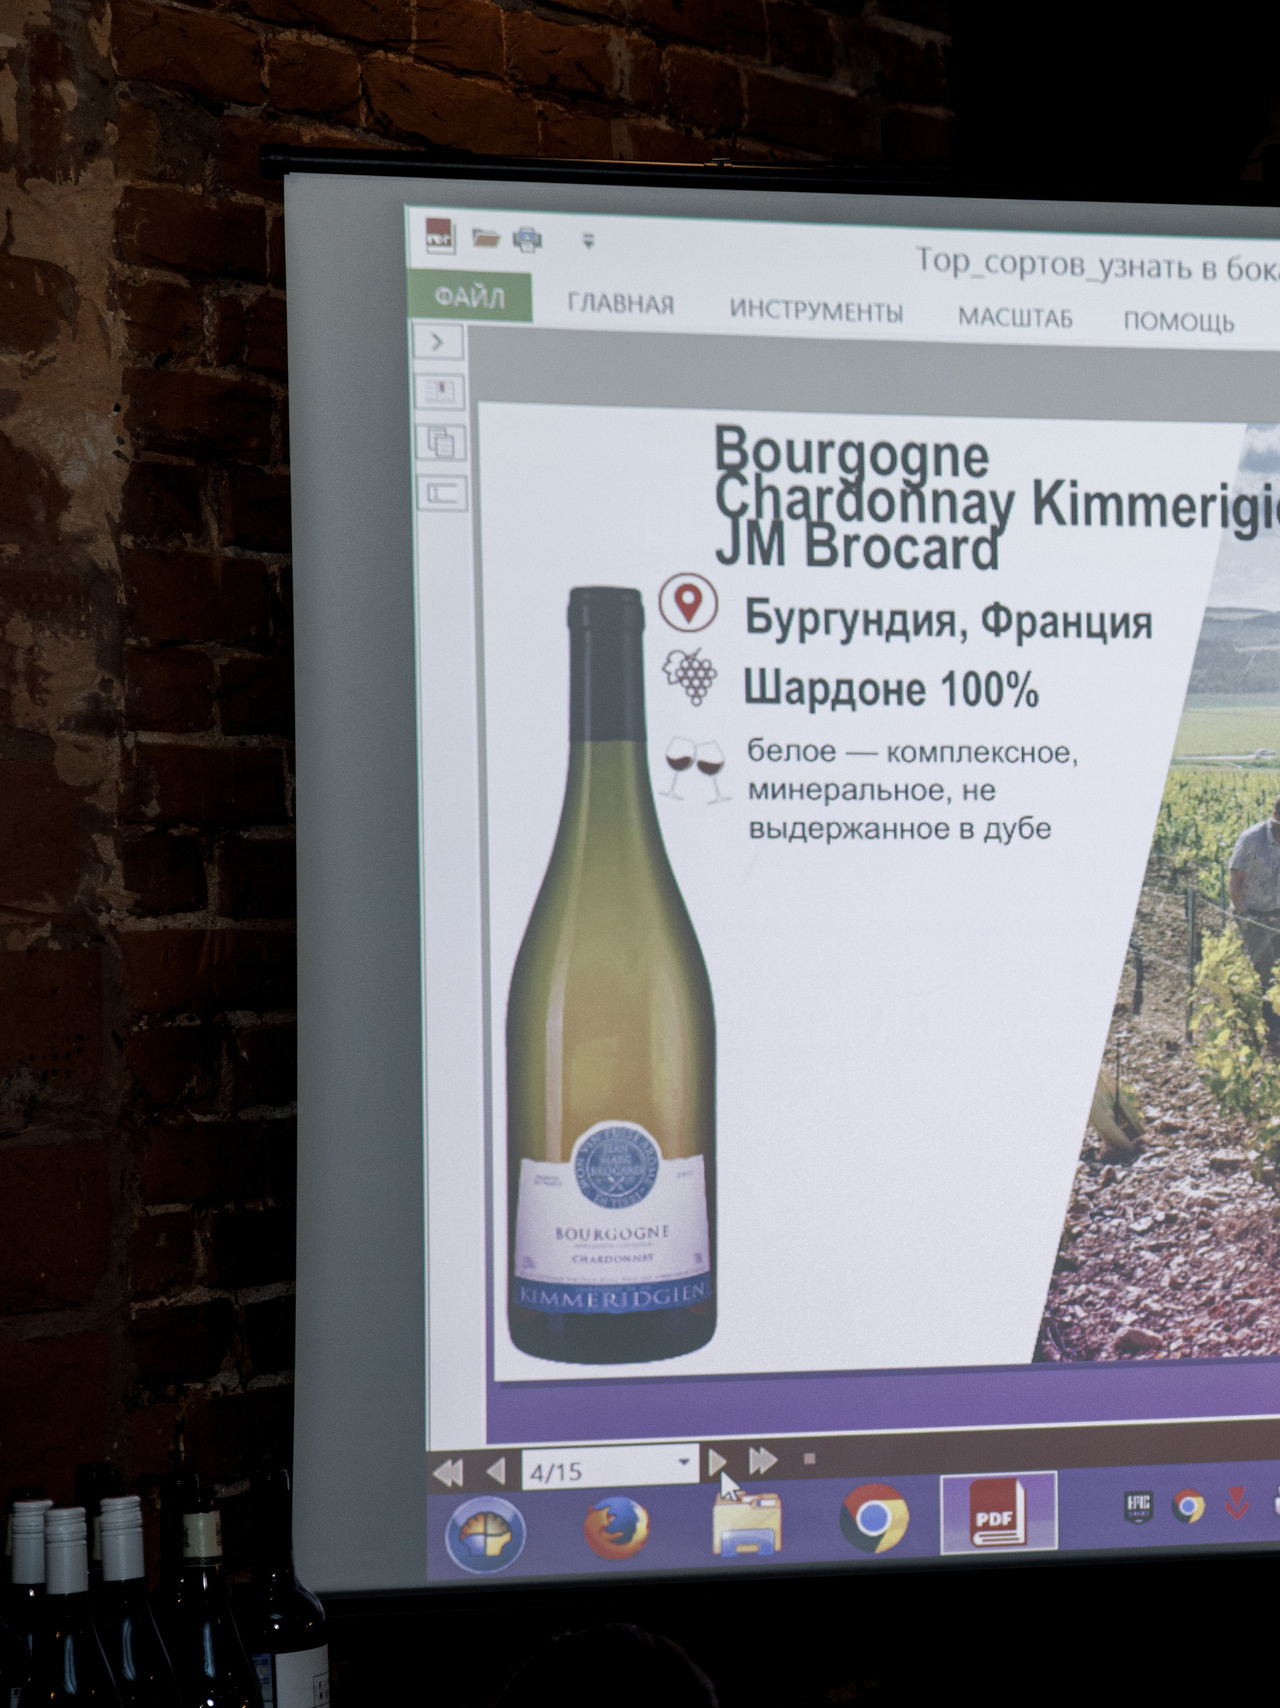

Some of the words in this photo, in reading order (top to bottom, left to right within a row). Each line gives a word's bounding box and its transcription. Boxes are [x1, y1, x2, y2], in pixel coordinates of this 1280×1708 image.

[1203, 260, 1217, 281] в
[435, 282, 506, 309] ФАЙЛ
[568, 291, 675, 315] ГЛАВНАЯ
[730, 298, 904, 324] ИНСТРУМЕНТЫ
[959, 306, 1074, 330] МАСШТАБ
[1125, 310, 1235, 335] ПОМОЩЬ
[715, 423, 990, 484] Bourgogne
[715, 469, 1015, 537] Chardonnay
[715, 519, 786, 567] JM
[806, 521, 1000, 571] Brocard
[746, 596, 968, 645] Бургундия,
[981, 600, 1153, 647] Франция
[744, 667, 926, 714] Шардоне
[941, 669, 1040, 709] 100%
[748, 738, 837, 763] белое
[887, 741, 1079, 768] комплексное,
[749, 780, 953, 806] минеральное,
[963, 781, 996, 801] не
[750, 817, 950, 845] выдержанное
[960, 818, 975, 839] в
[984, 815, 1052, 846] дубе
[555, 1225, 670, 1241] BOURGOGNE
[572, 1253, 655, 1264] CHARDONNAY
[520, 1282, 705, 1309] KIMMERIDGIEN
[529, 1461, 583, 1485] 4/15
[976, 1511, 1014, 1528] PDF
